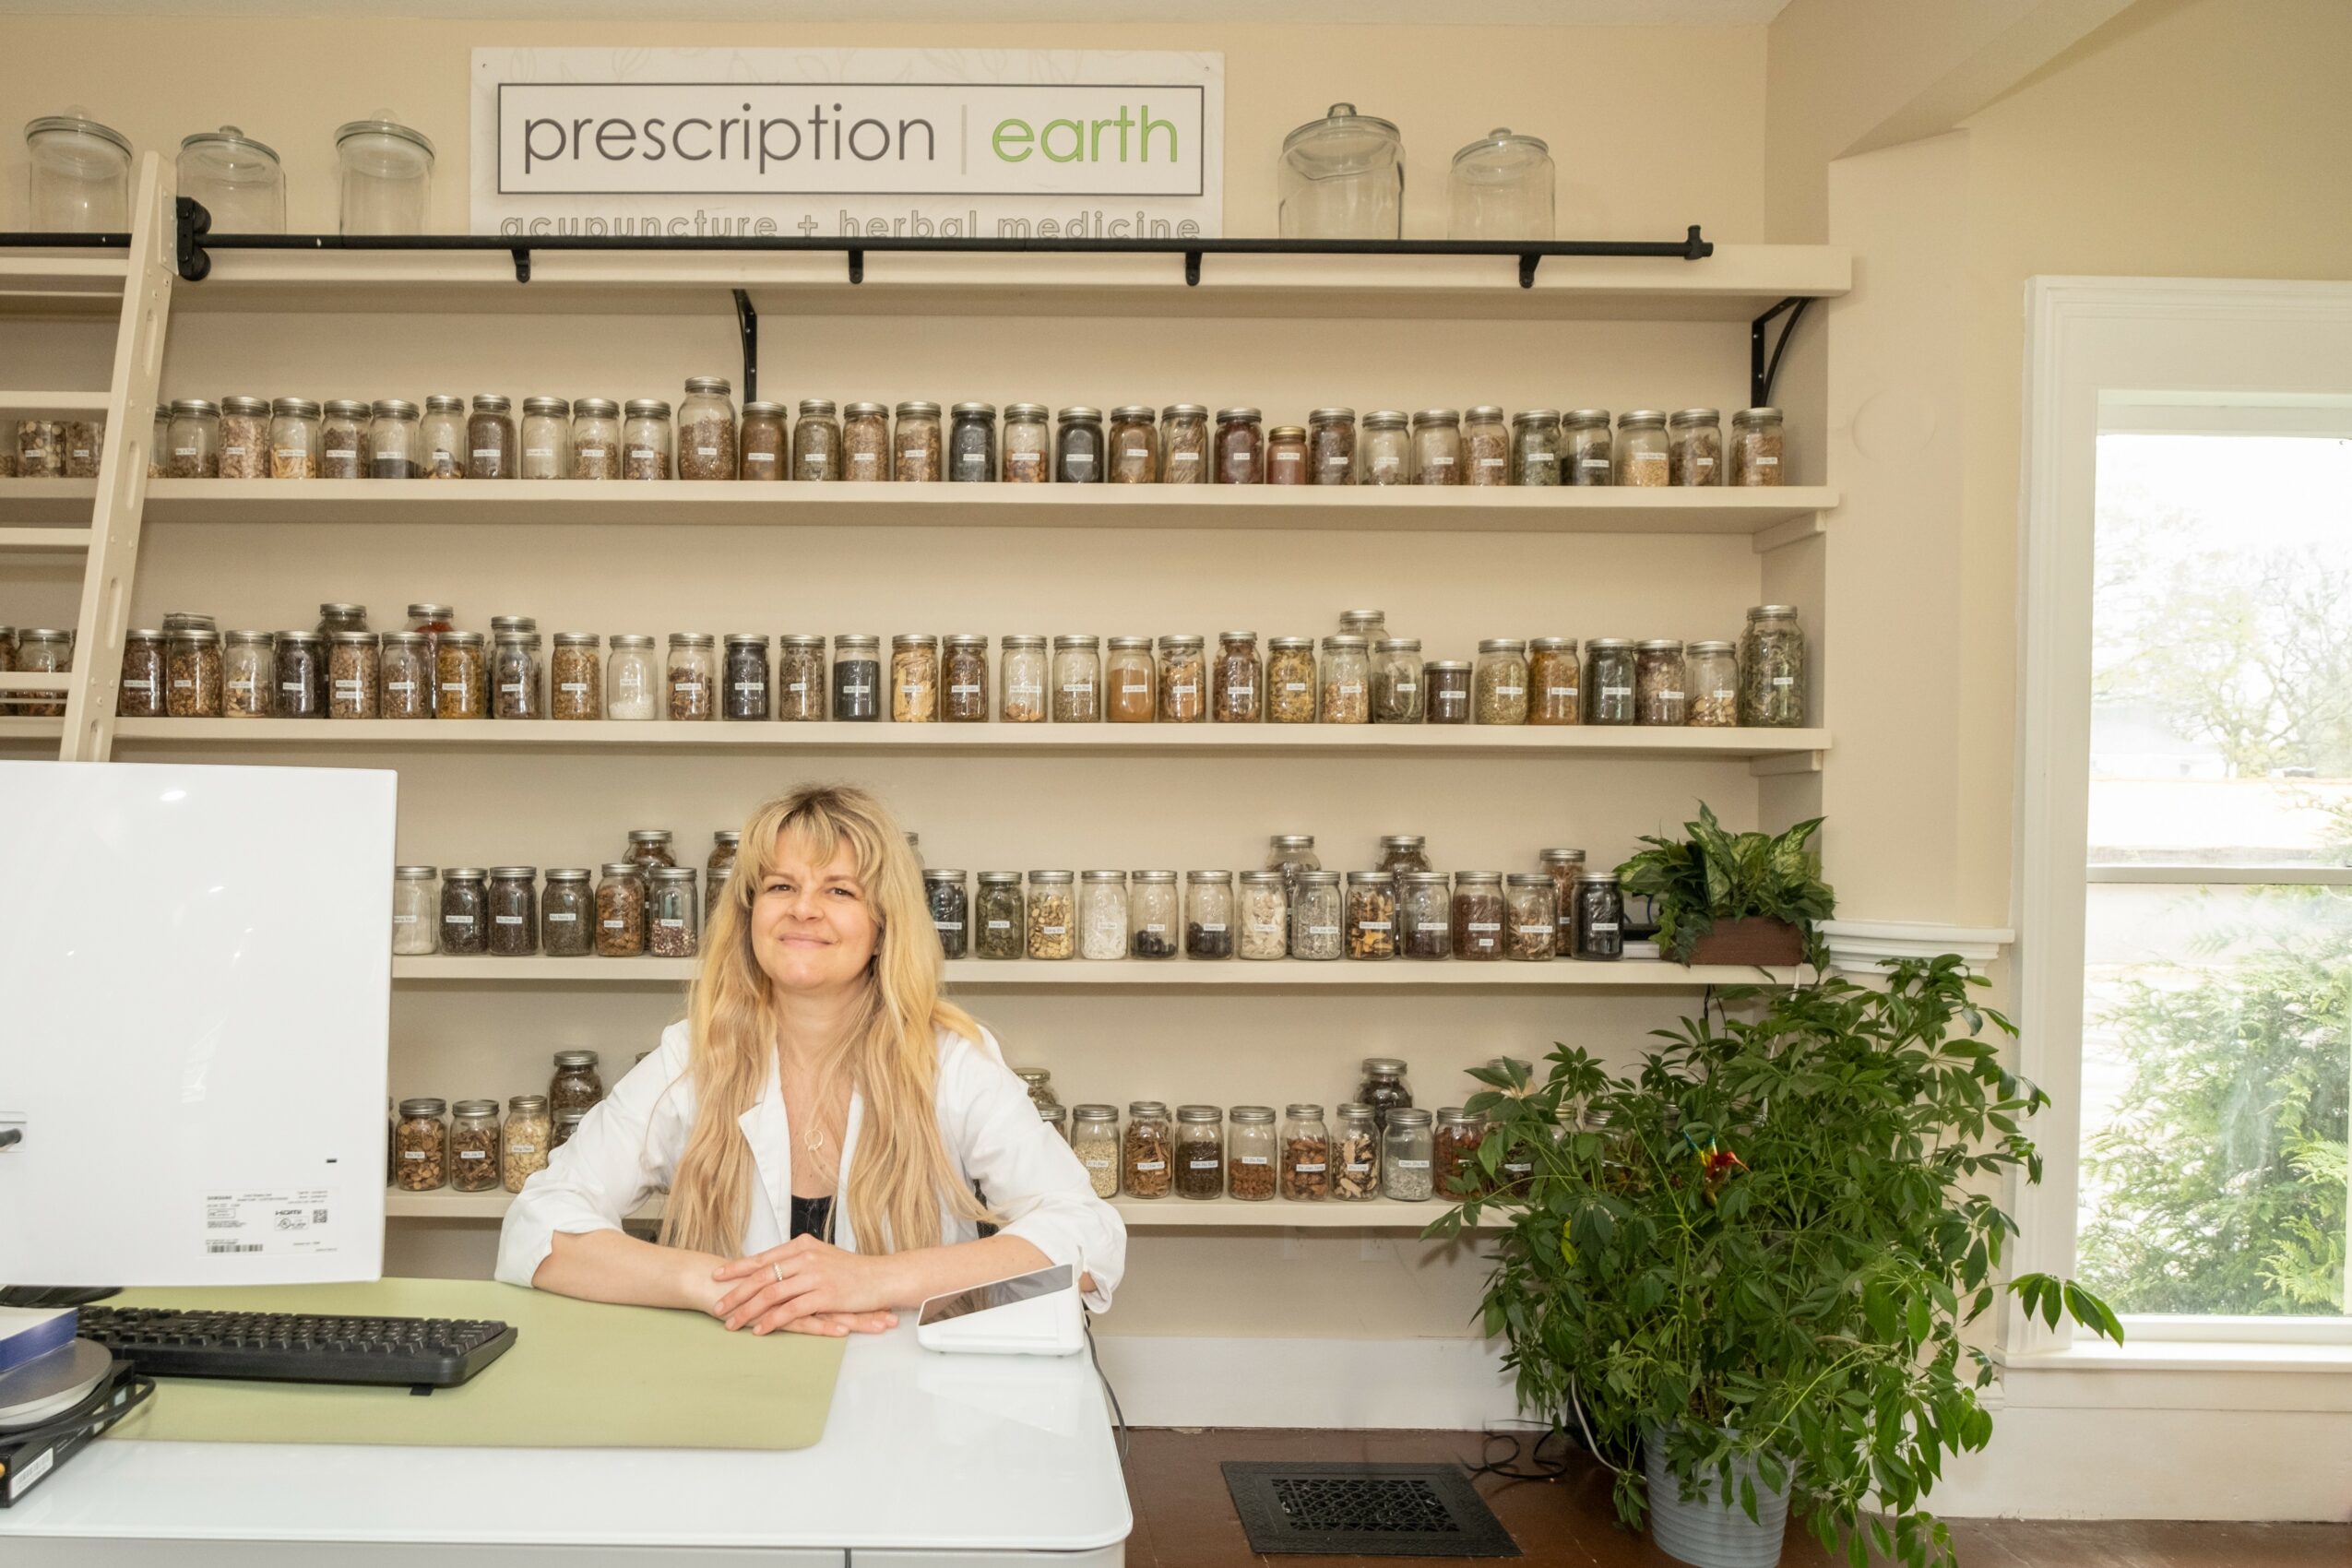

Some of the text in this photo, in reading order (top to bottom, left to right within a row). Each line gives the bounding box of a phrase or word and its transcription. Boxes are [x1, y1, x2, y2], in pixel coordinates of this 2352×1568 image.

[524, 103, 1179, 173] prescription earth
[500, 209, 778, 237] acupuncture
[839, 209, 977, 238] herbal
[998, 210, 1201, 239] medicine
